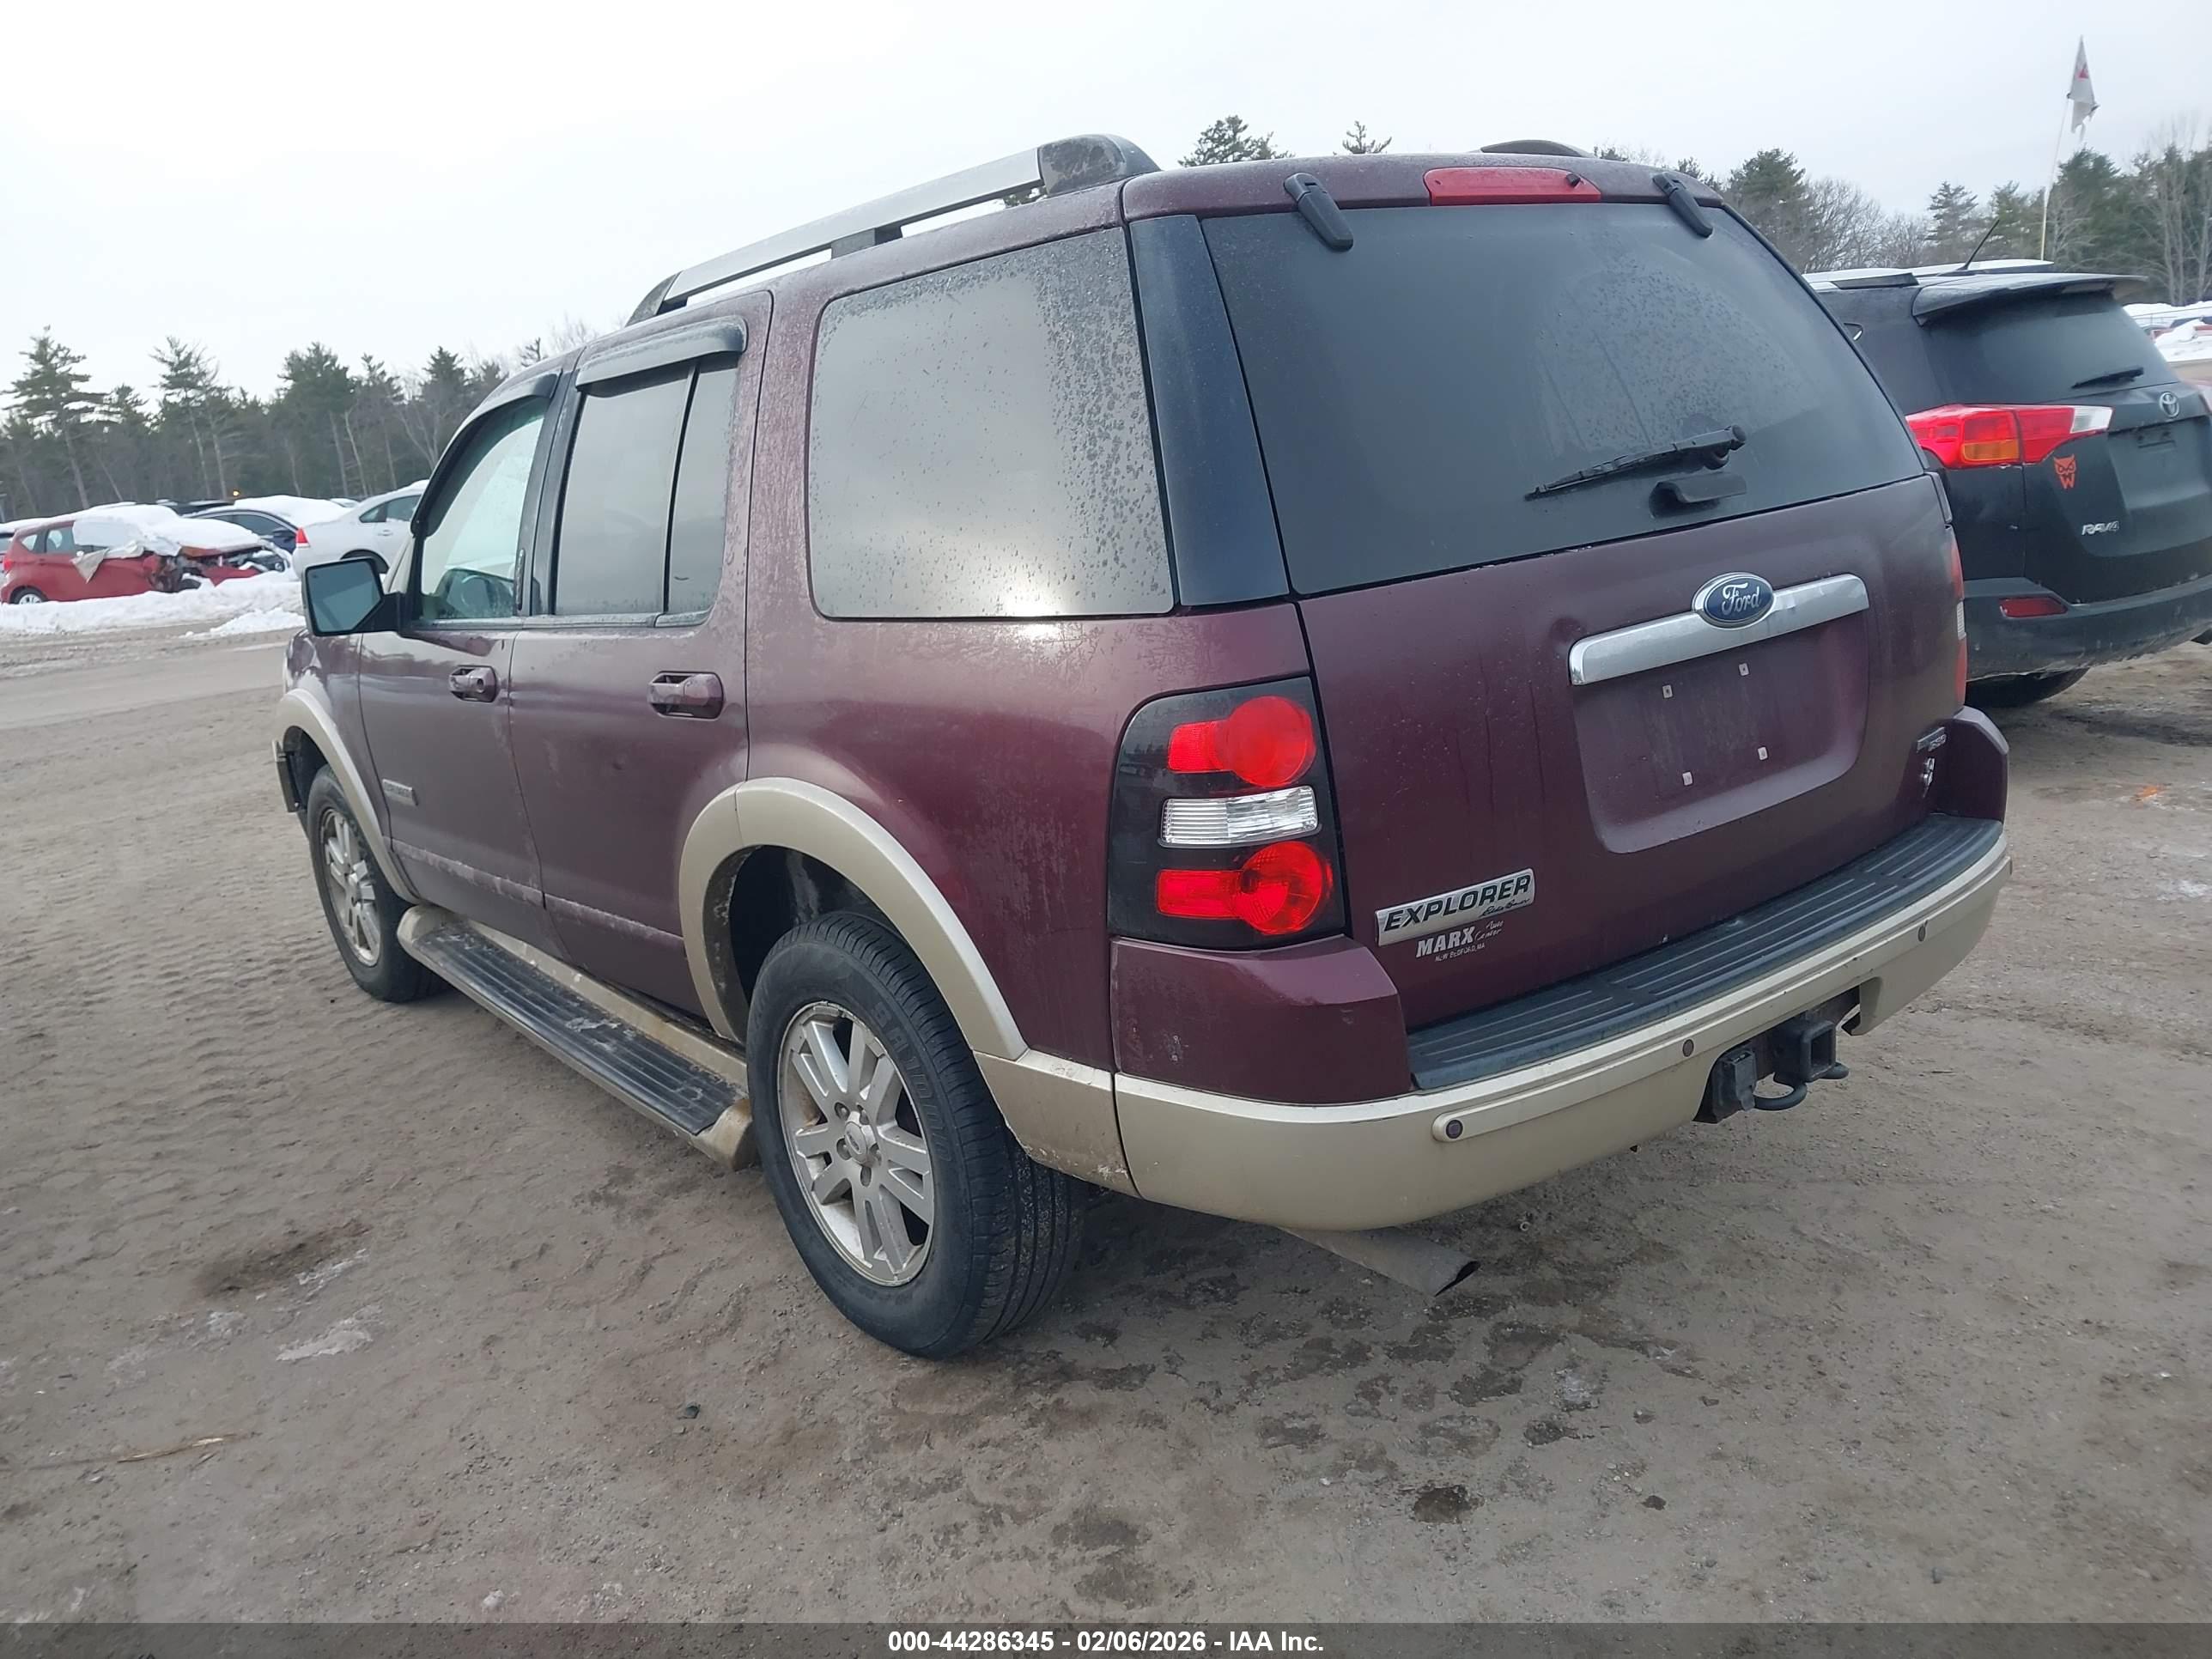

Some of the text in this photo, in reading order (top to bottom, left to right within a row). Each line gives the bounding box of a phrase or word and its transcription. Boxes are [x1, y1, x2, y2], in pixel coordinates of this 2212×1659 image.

[2081, 520, 2120, 536] RAV4
[1721, 581, 1761, 616] Ford
[1383, 874, 1531, 932] EXPLORER
[1415, 926, 1475, 958] MARX
